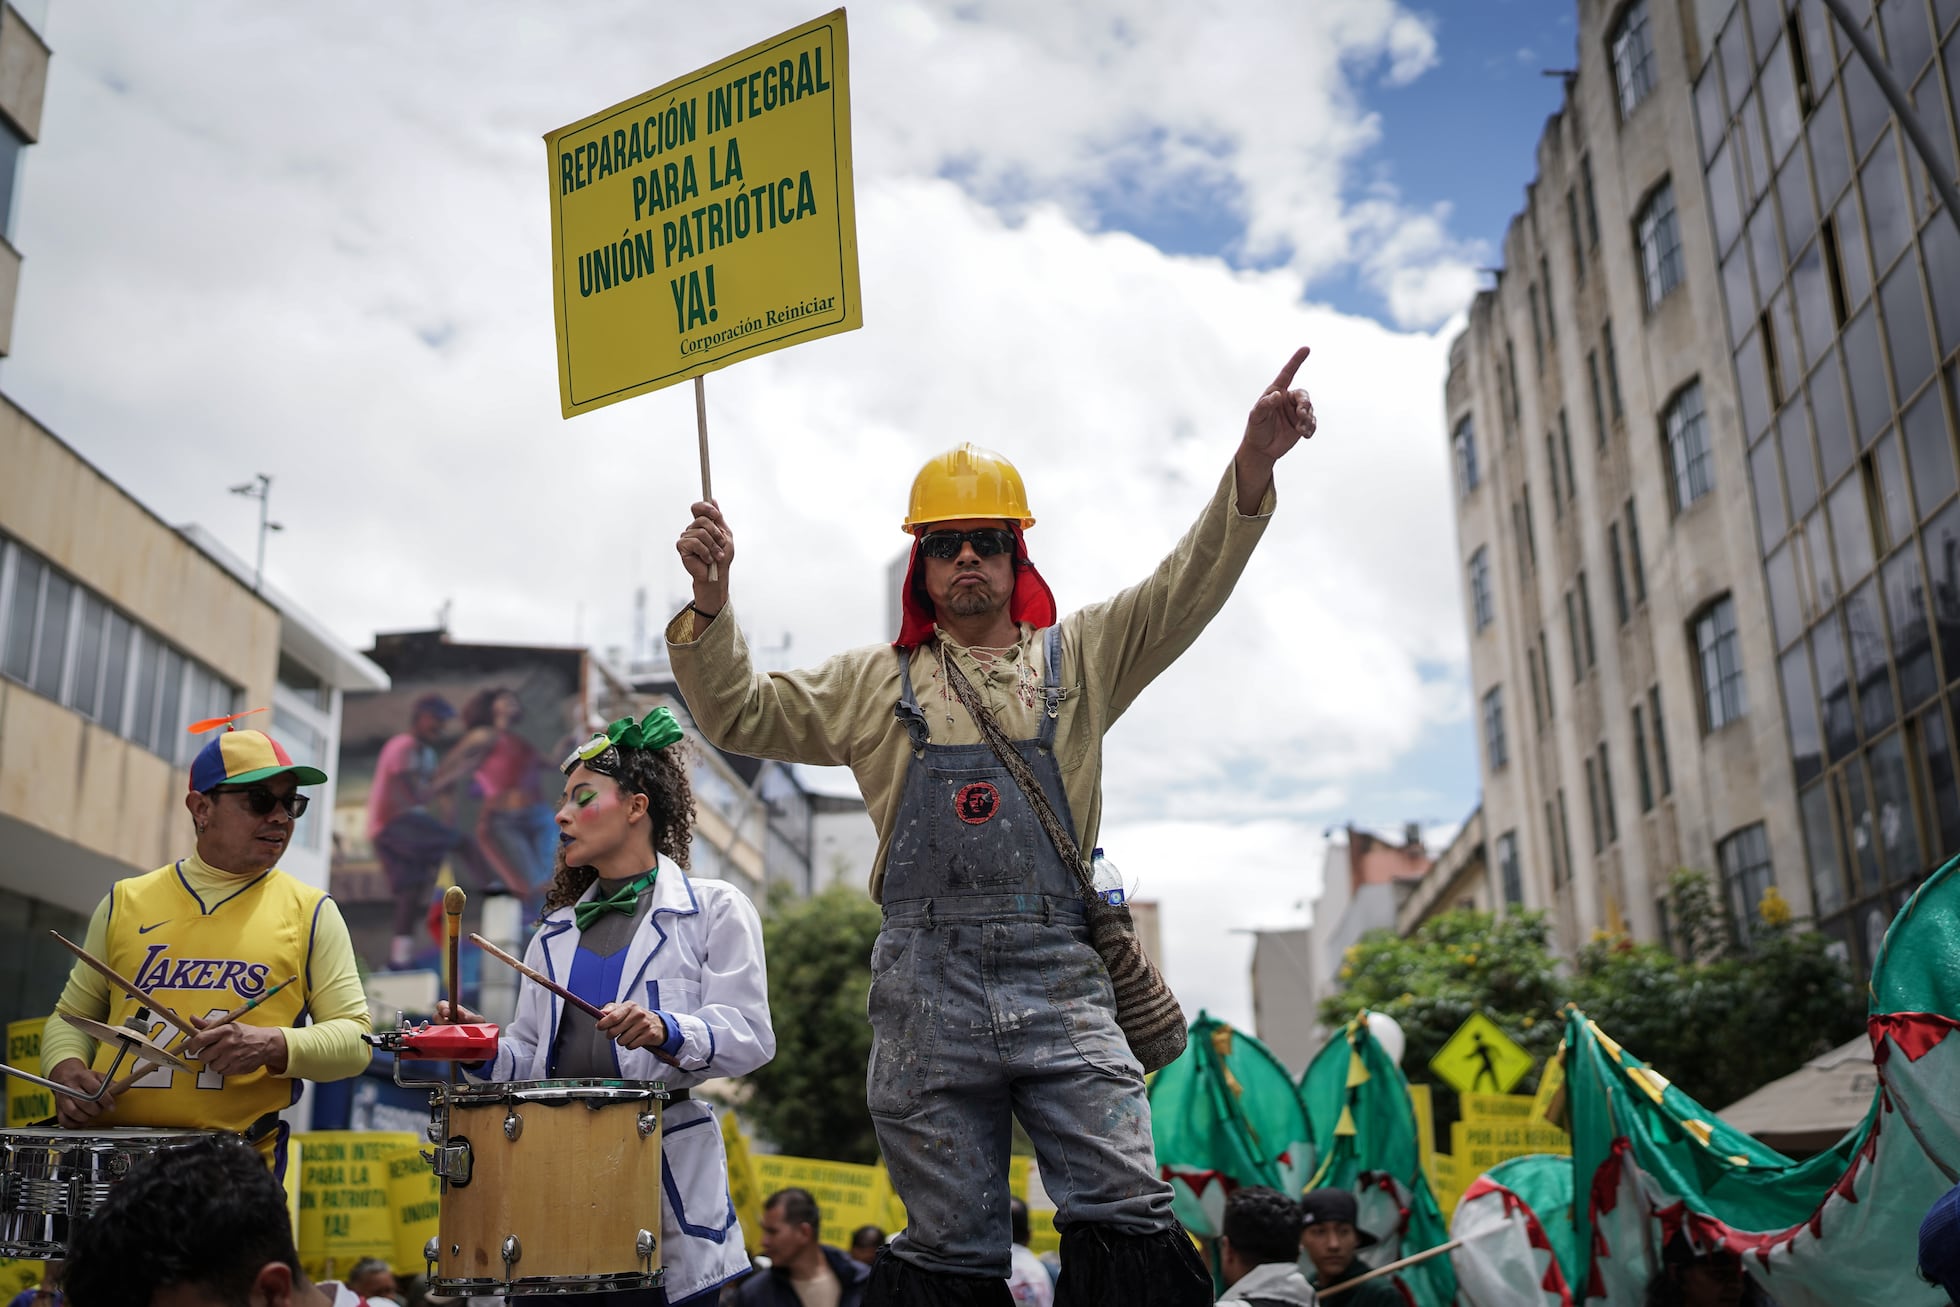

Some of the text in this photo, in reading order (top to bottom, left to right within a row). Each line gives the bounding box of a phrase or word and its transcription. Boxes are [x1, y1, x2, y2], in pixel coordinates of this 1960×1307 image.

[561, 46, 830, 196] REPARACIÓN INTEGRAL
[632, 137, 743, 221] PARA LA
[577, 169, 817, 298] UNIÓN PATRIÓTICA
[671, 264, 718, 334] YA!
[680, 295, 835, 355] Corporación Reiniciar
[125, 944, 270, 999] LAKERS
[307, 1165, 369, 1184] PARA LA
